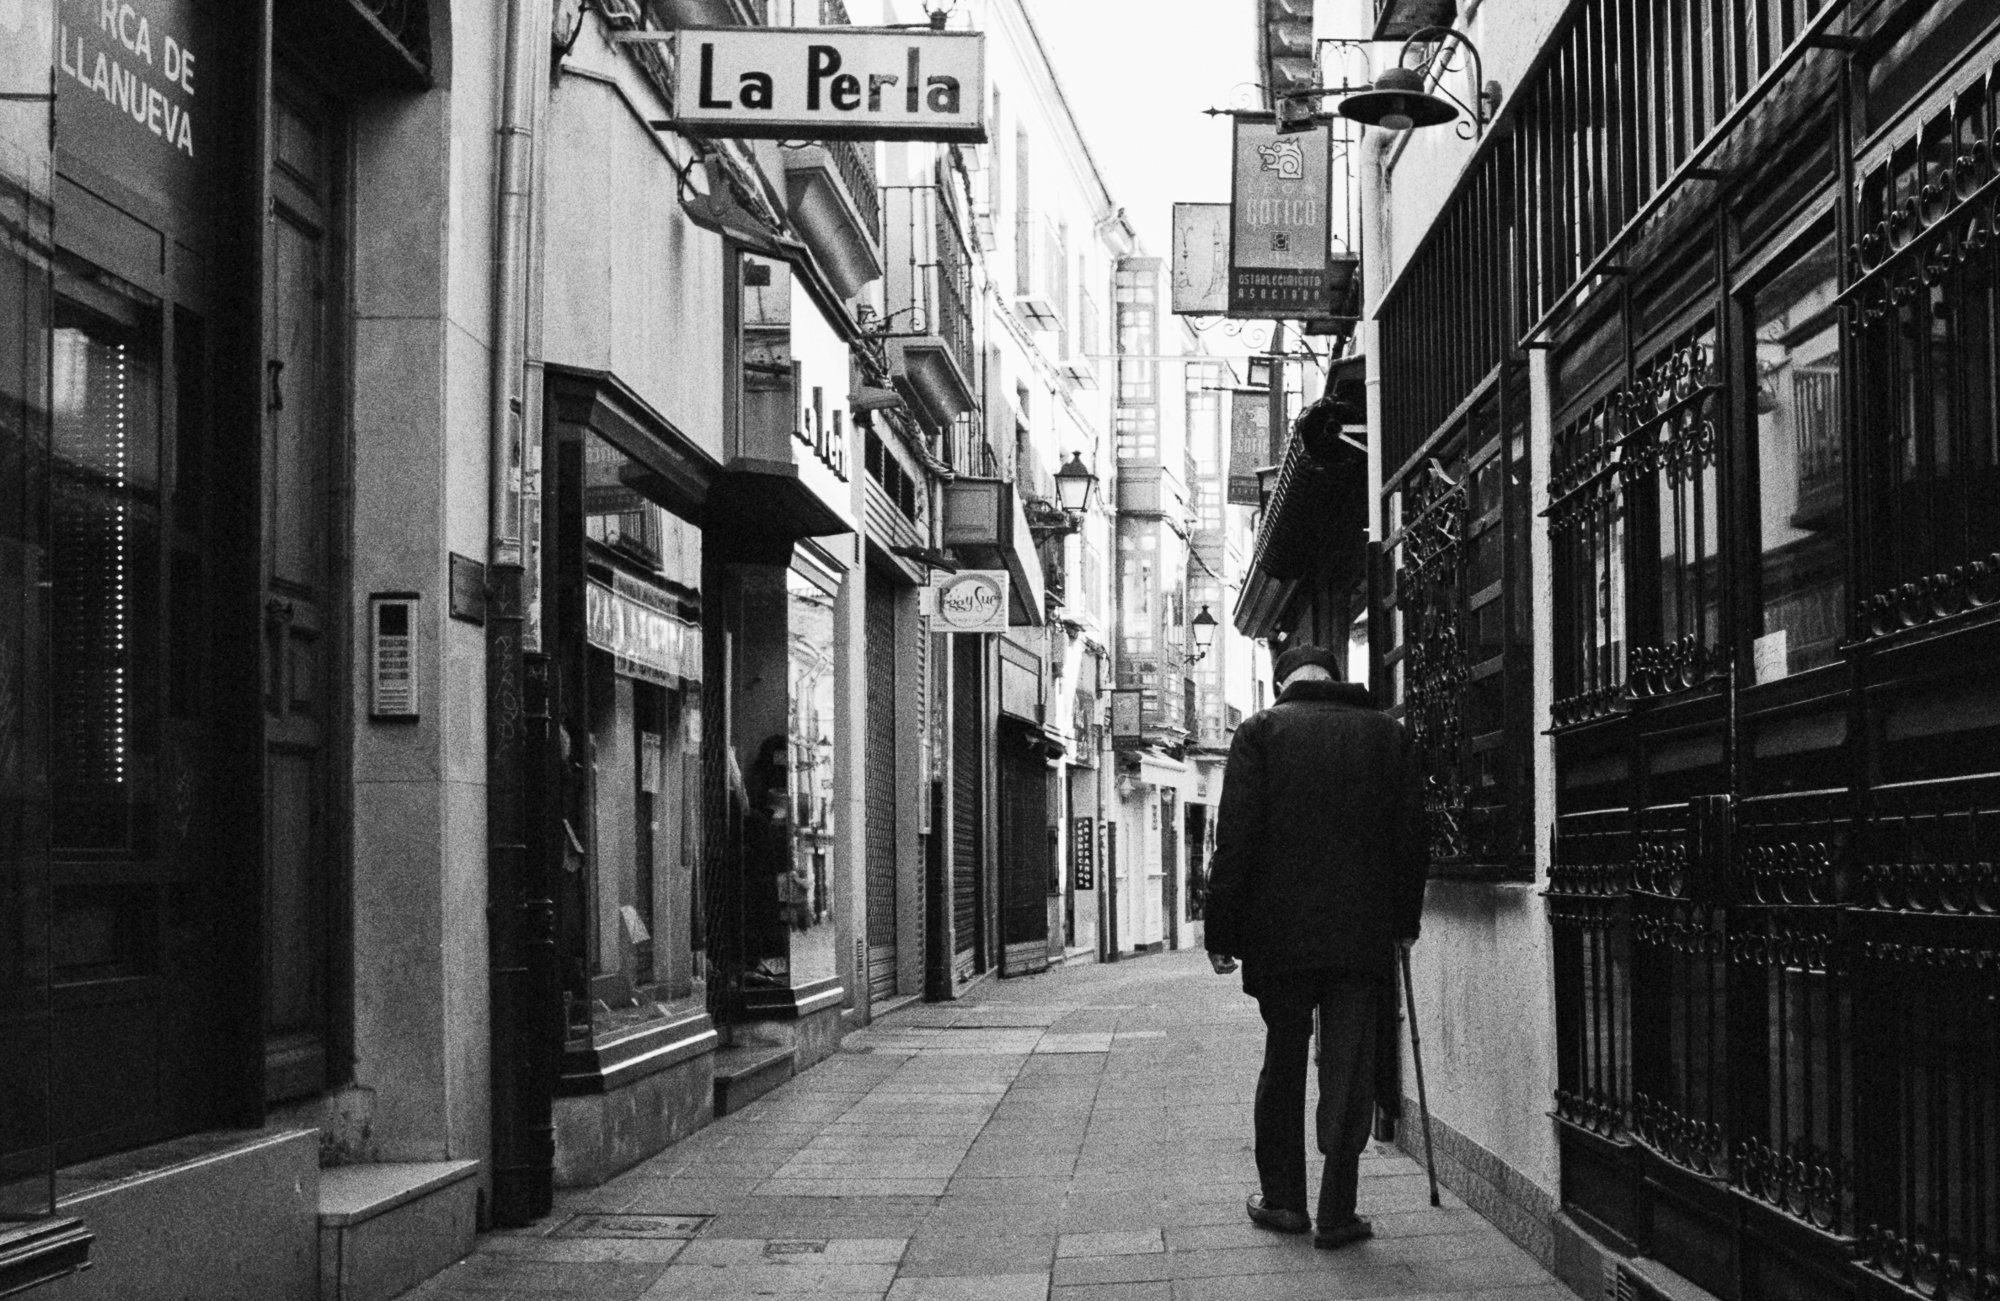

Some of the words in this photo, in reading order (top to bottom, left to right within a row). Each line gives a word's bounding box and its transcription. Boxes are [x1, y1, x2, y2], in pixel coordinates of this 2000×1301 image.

[60, 24, 193, 157] LLANUEVA
[164, 35, 195, 96] DE
[699, 43, 773, 109] La
[807, 45, 960, 113] Perla
